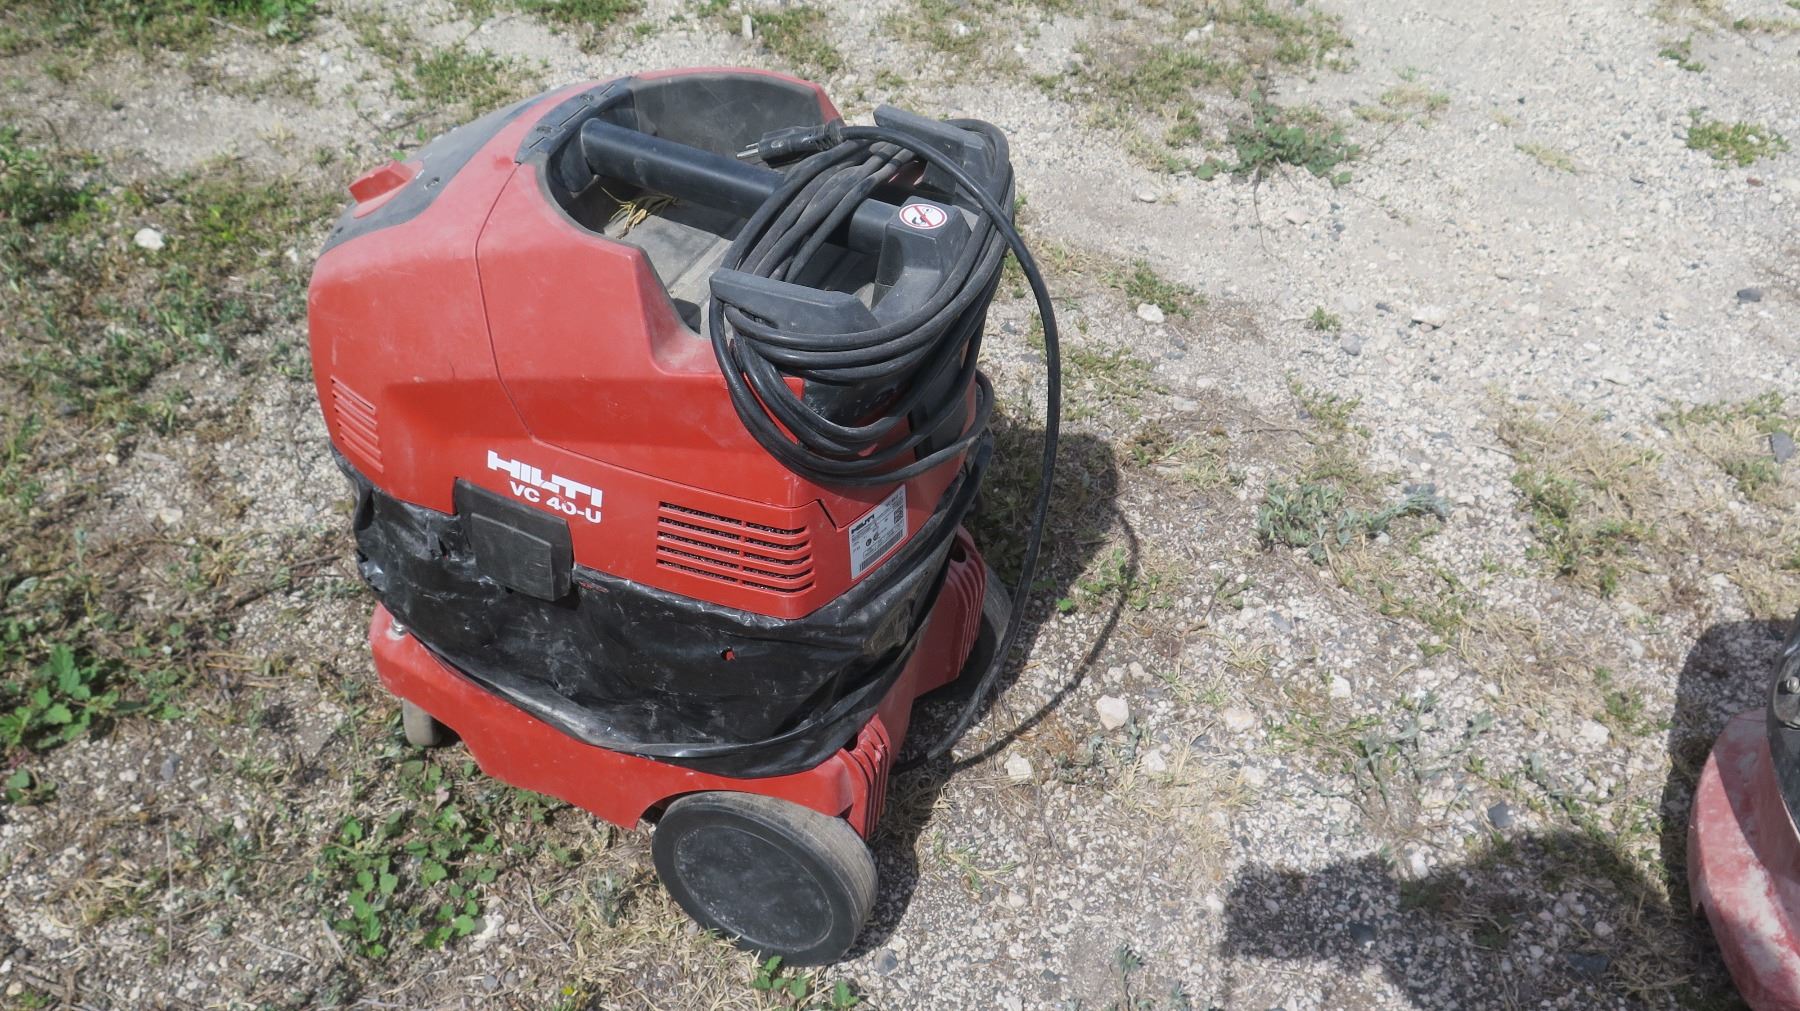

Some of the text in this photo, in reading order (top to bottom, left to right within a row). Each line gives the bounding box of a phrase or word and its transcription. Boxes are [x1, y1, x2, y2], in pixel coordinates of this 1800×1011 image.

[487, 449, 602, 508] HILTI
[510, 480, 601, 523] VC 40-U
